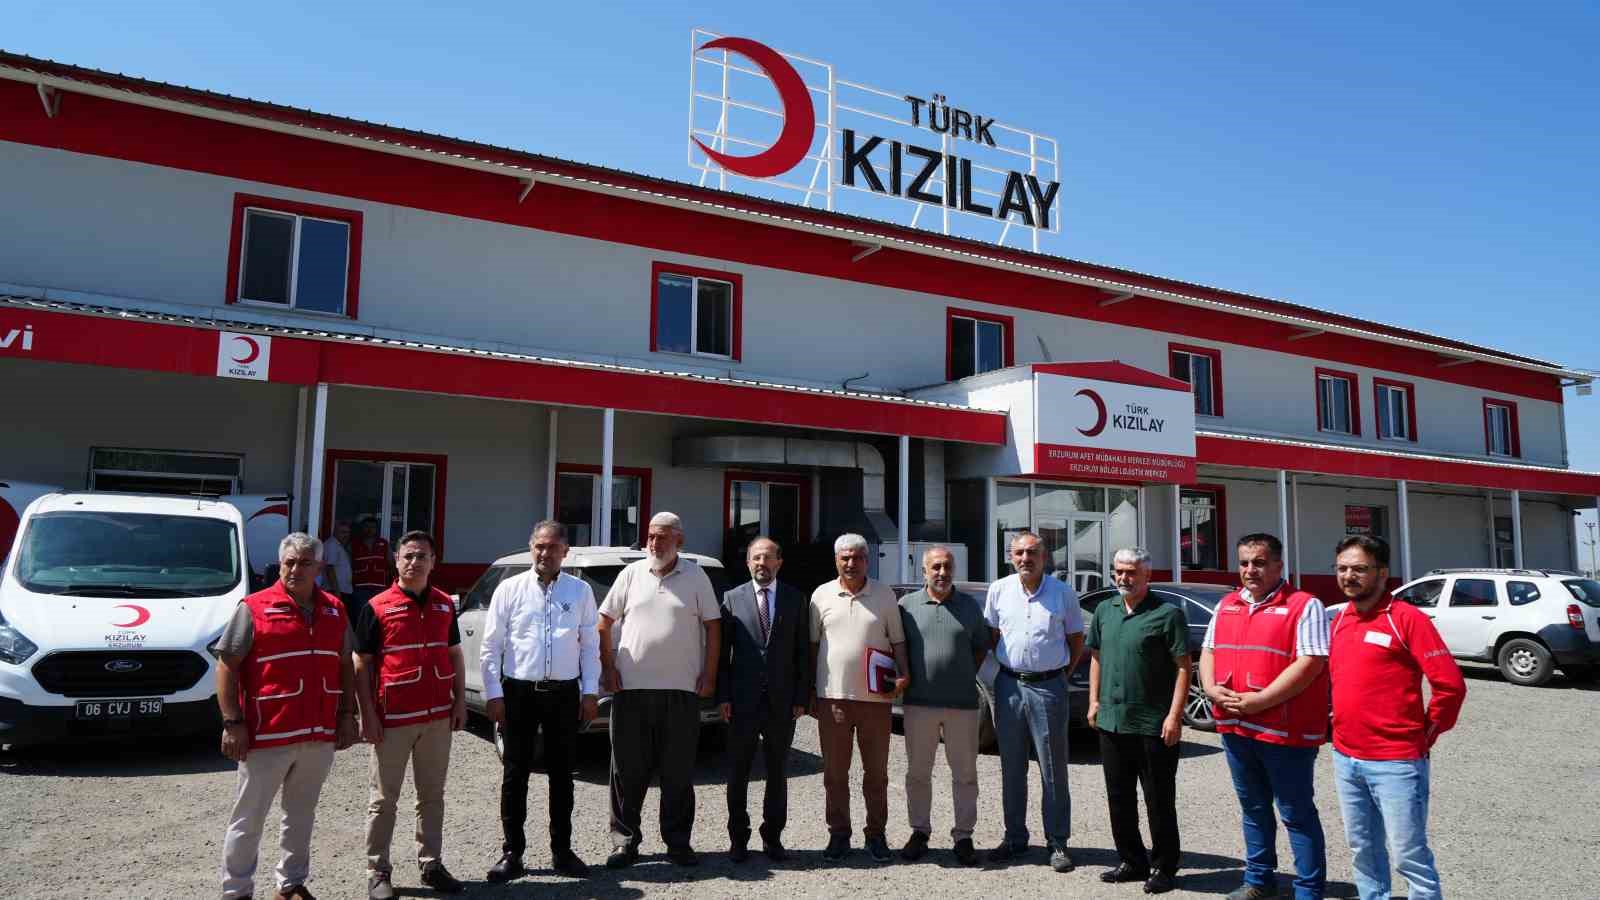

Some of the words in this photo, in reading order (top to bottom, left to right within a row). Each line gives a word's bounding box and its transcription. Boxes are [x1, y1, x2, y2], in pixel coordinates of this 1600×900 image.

[904, 94, 996, 148] TÜRK
[842, 128, 1060, 229] KIZILAY
[1126, 403, 1149, 415] TÜRK
[1112, 415, 1164, 433] KIZILAY
[1048, 449, 1079, 459] ERZURUM
[1080, 452, 1094, 461] AFET
[1071, 463, 1098, 473] ERZURUM
[85, 703, 101, 716] 06
[108, 702, 131, 715] CVJ
[139, 701, 161, 713] 519
